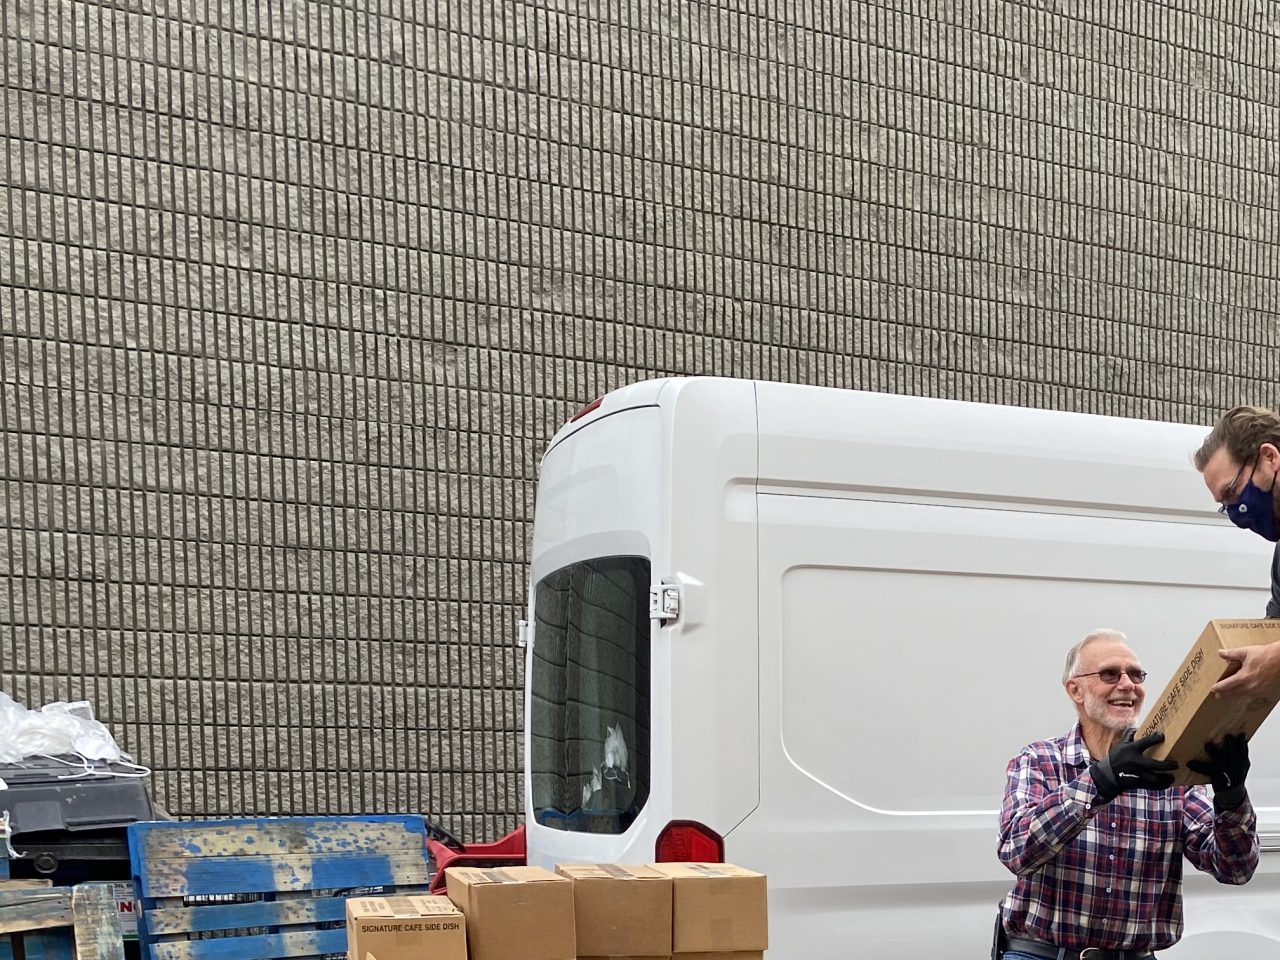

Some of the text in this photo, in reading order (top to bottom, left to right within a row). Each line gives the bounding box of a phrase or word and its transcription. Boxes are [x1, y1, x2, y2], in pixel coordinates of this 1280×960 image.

[1167, 684, 1180, 705] CAFE
[1179, 667, 1193, 687] SIDE
[1191, 648, 1204, 669] DISH
[362, 925, 402, 933] SIGNATURE
